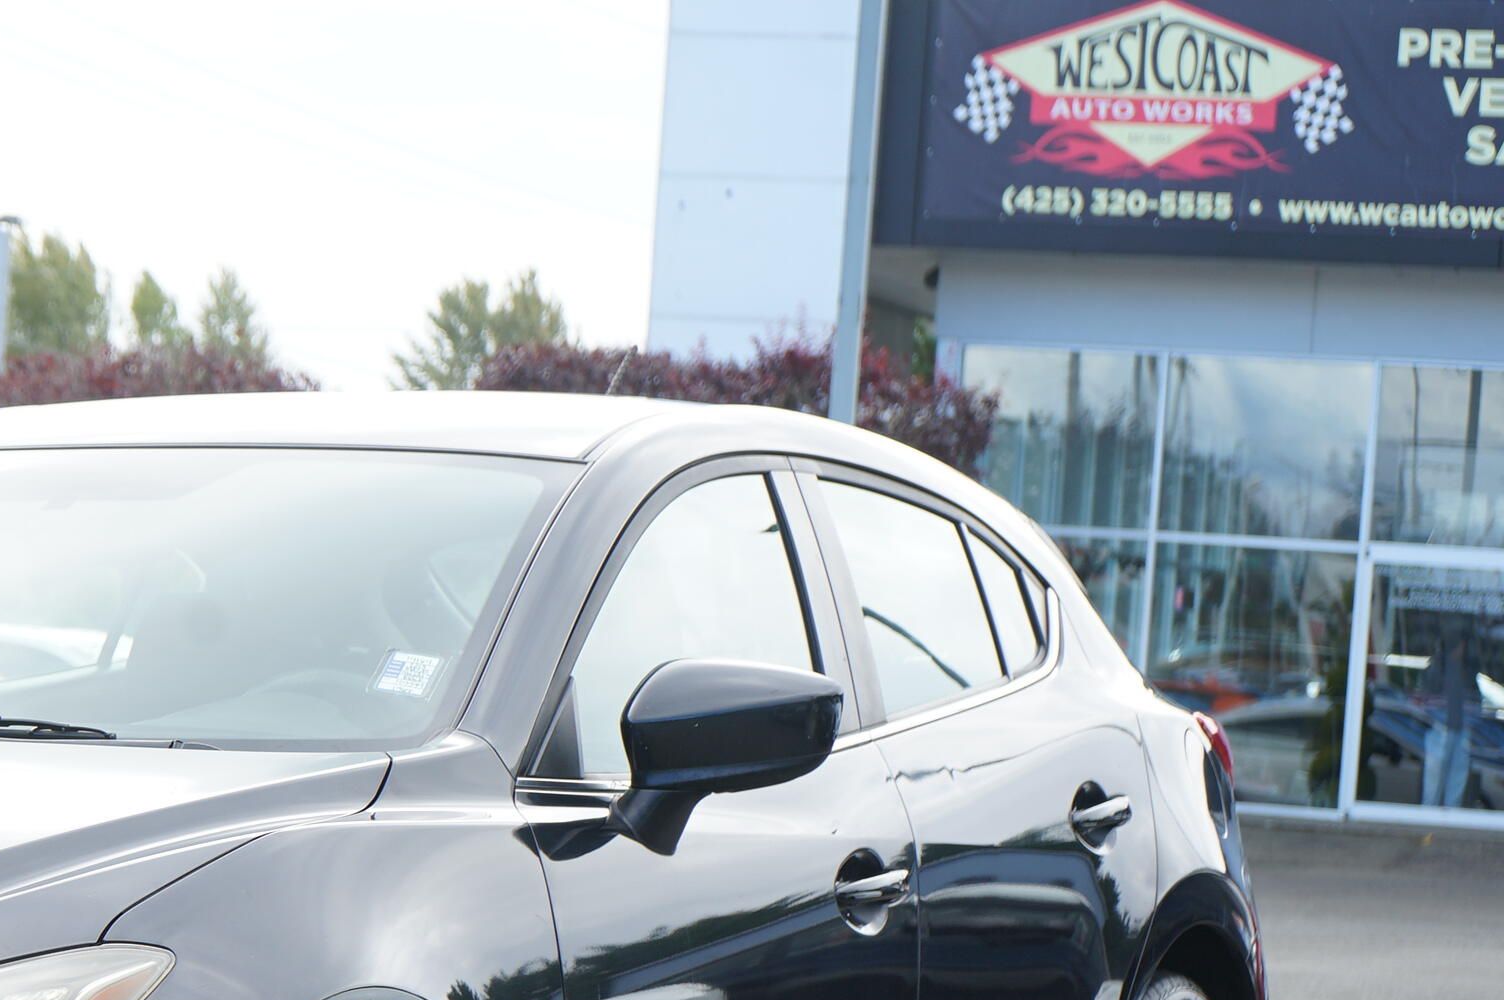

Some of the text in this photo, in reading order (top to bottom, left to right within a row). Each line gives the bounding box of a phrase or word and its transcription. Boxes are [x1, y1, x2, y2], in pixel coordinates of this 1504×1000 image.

[1397, 27, 1504, 69] PRE-
[1051, 97, 1253, 125] AUTO WORKS
[1464, 124, 1504, 167] S
[1001, 184, 1085, 218] (425)
[1090, 188, 1234, 220] 320-5555
